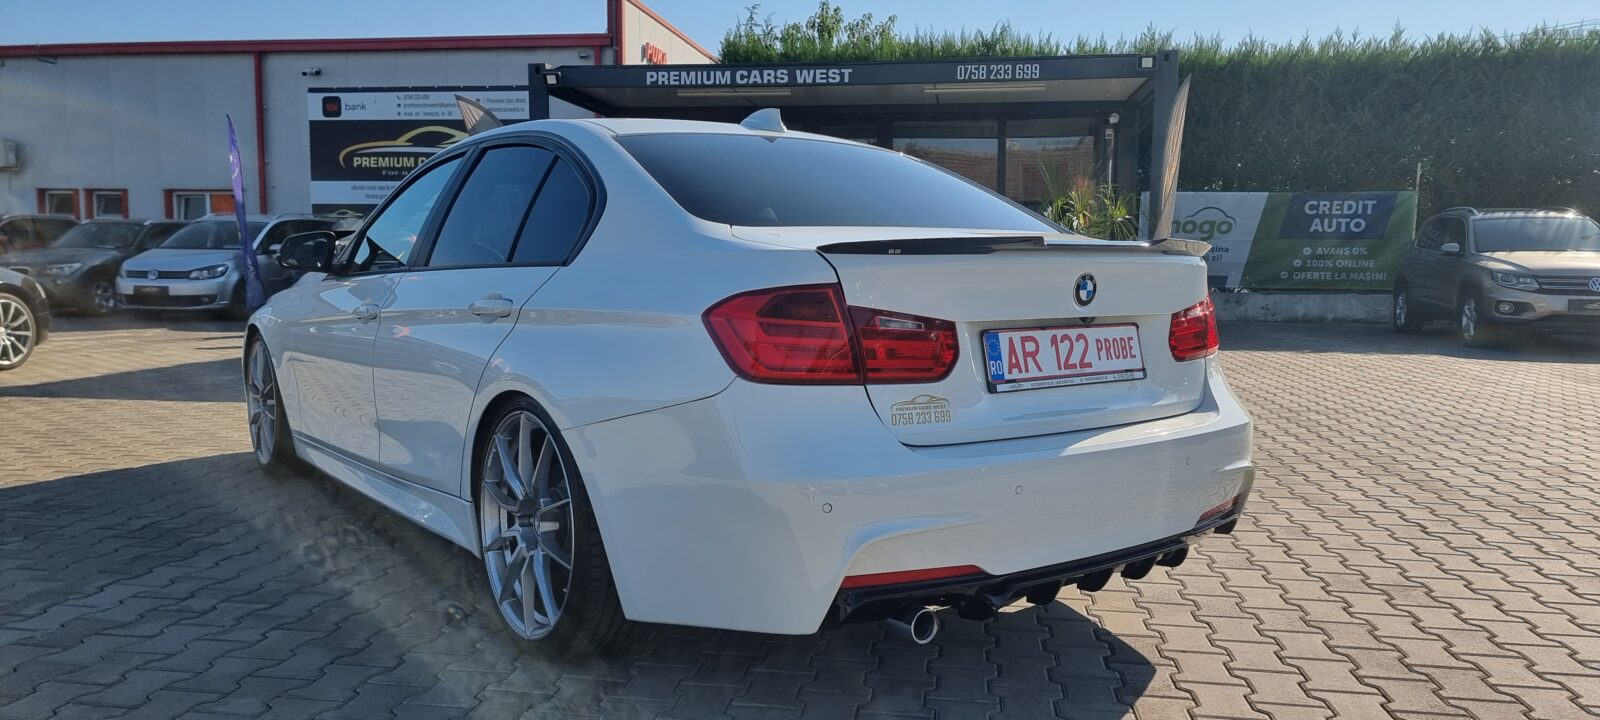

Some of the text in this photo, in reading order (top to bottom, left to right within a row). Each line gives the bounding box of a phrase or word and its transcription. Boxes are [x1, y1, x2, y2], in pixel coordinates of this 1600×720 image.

[646, 68, 853, 85] PREMIUM CARS WEST
[956, 63, 1040, 80] 0758 233 699
[344, 102, 367, 111] bank
[353, 156, 415, 168] PREMIUM
[1304, 200, 1377, 215] CREDIT
[1309, 217, 1367, 233] AUTO
[1315, 247, 1368, 256] AVANS 0%
[1306, 259, 1376, 269] 100% ONLINE
[1292, 271, 1332, 280] OFERTE
[1334, 271, 1347, 280] LA
[1007, 332, 1137, 375] AR 122 PROBE
[990, 360, 1004, 376] RO
[890, 409, 952, 427] 0758 233 699
